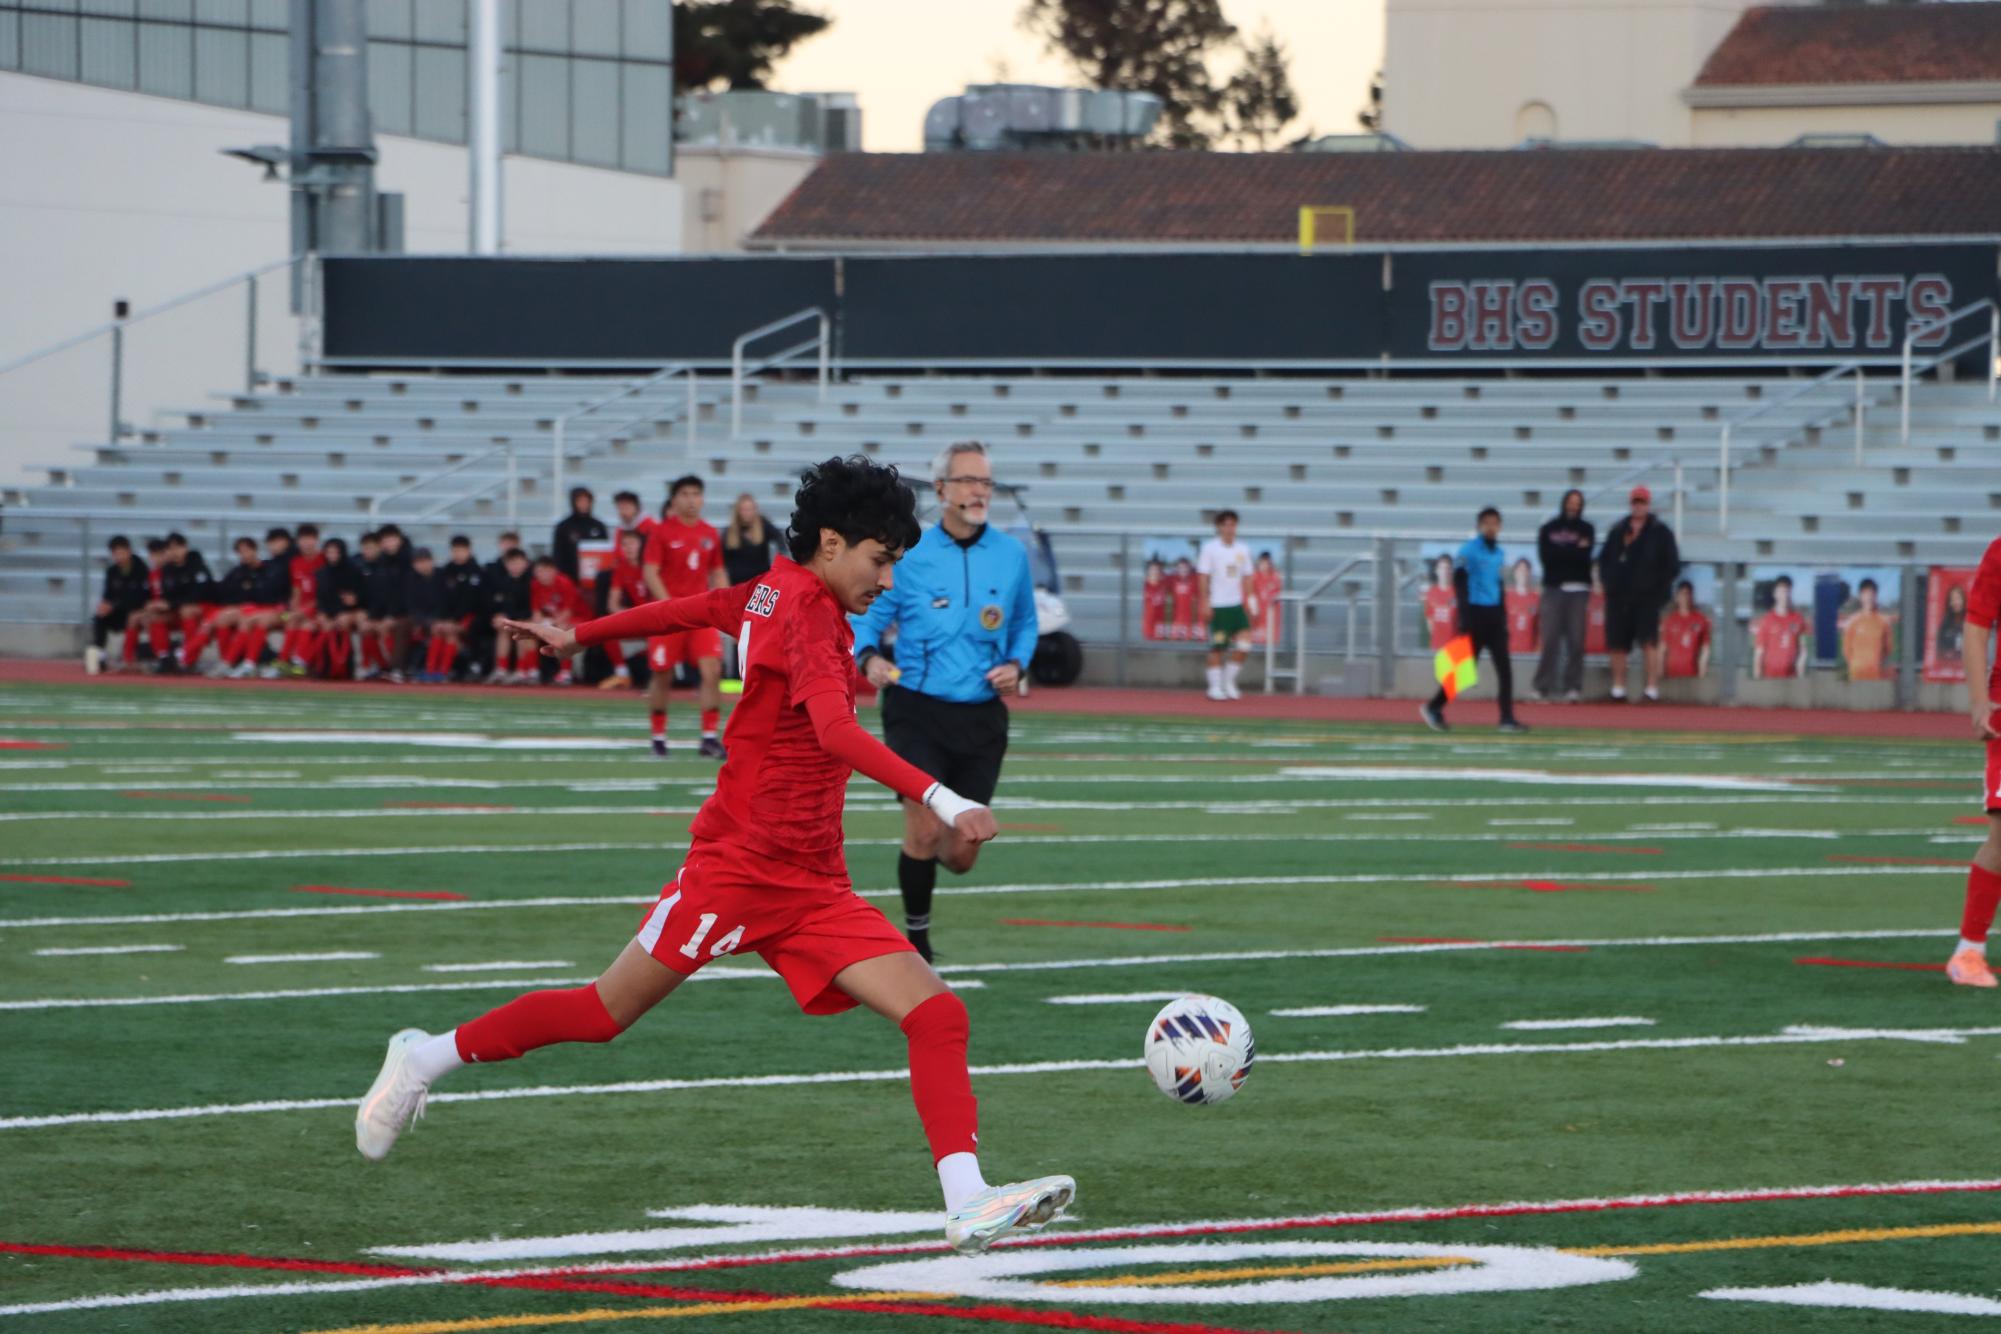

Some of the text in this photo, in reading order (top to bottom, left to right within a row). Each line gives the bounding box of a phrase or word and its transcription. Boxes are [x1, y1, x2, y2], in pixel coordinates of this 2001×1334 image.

[1428, 273, 1953, 351] BHS STUDENTS
[653, 646, 666, 667] 4
